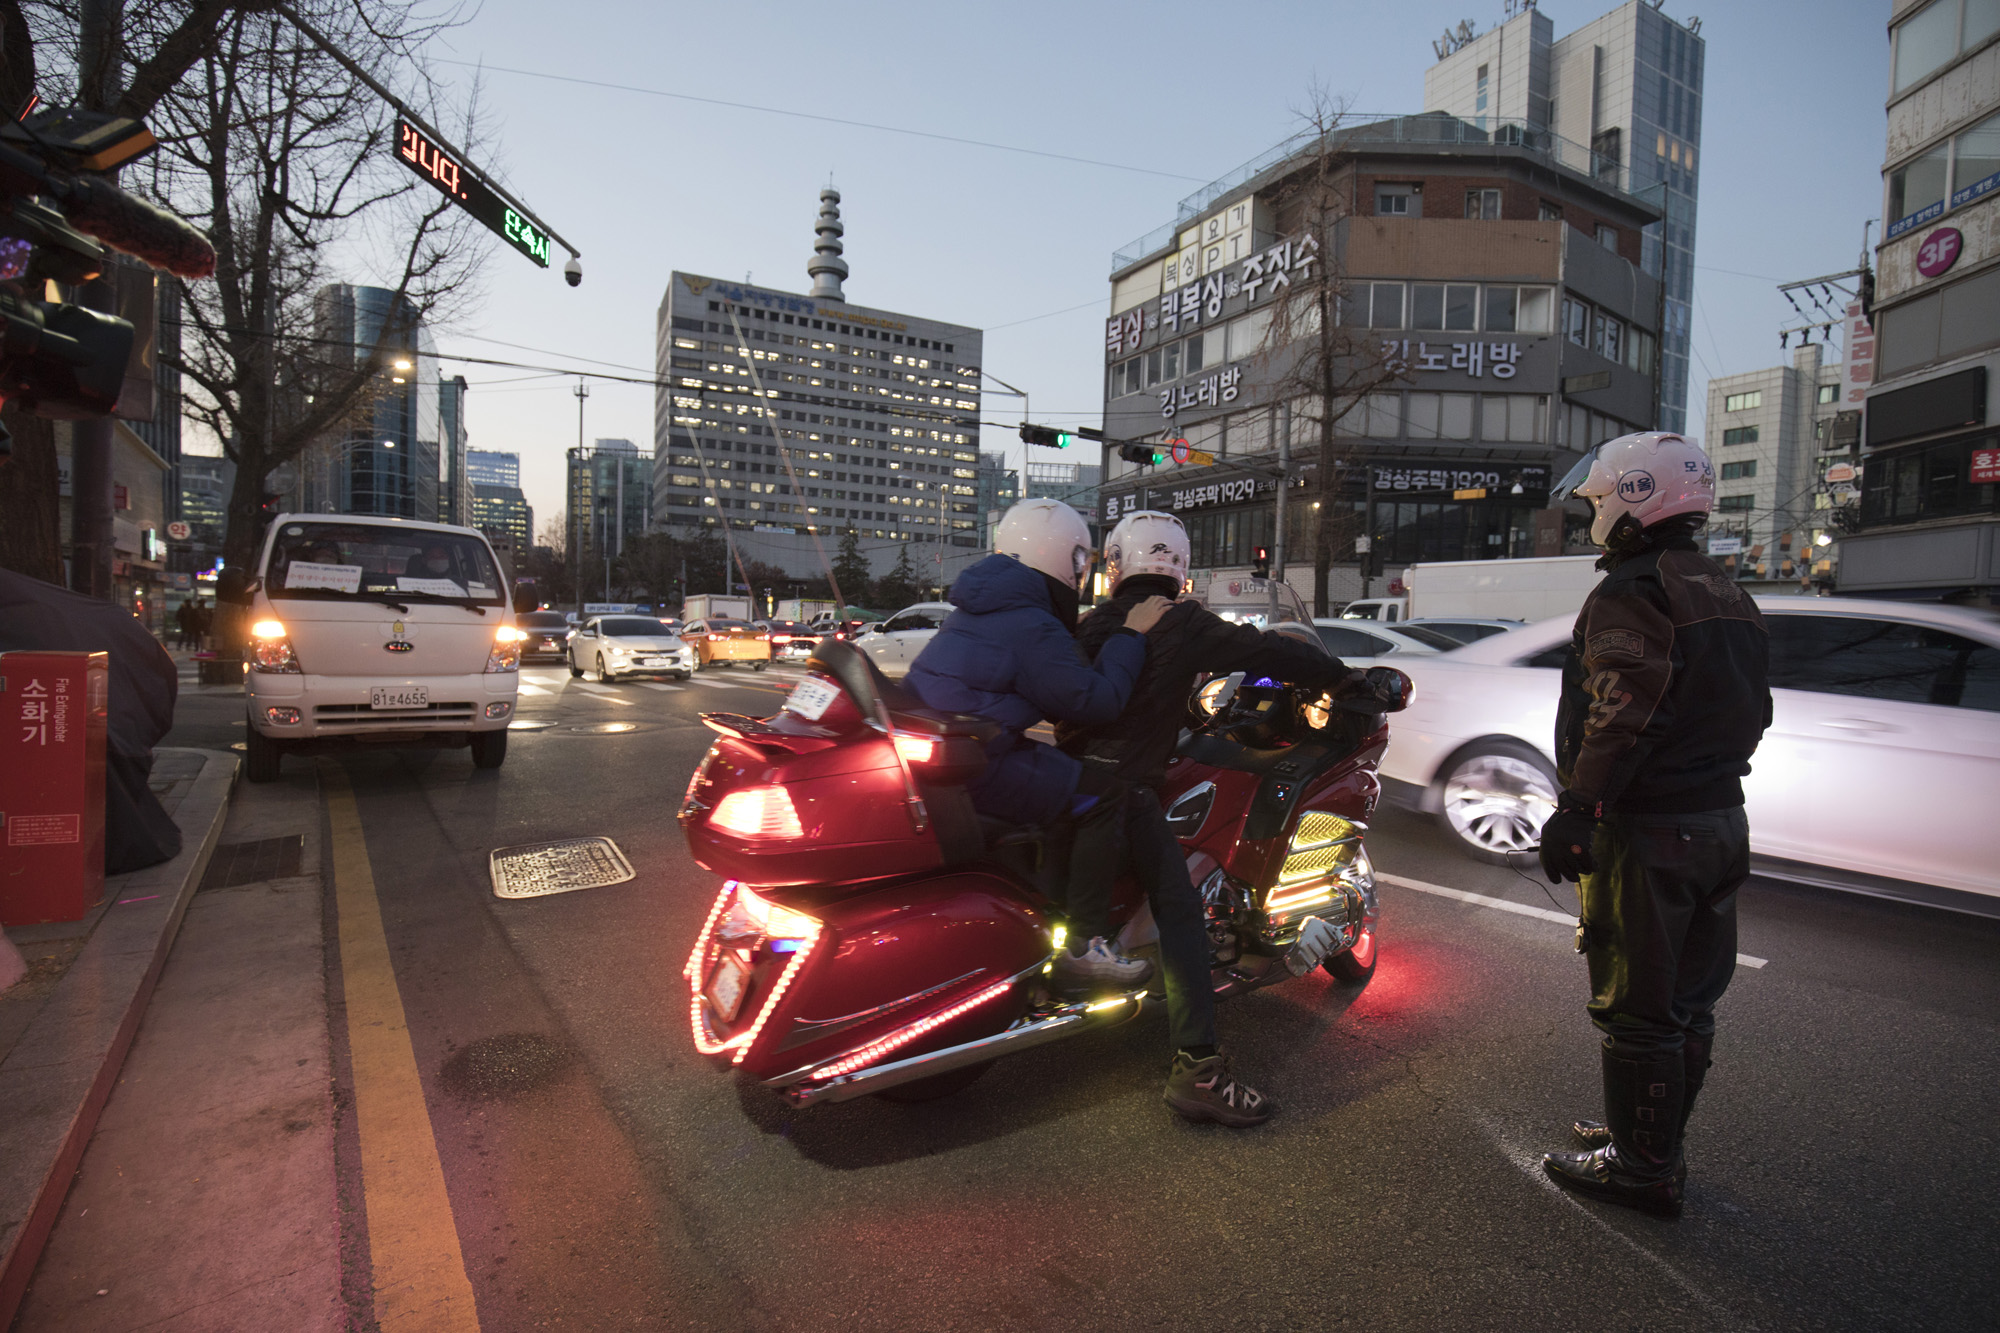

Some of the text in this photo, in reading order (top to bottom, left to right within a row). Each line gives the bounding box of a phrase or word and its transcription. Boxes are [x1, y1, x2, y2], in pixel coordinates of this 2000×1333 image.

[505, 208, 550, 266] 단속시
[1208, 204, 1246, 240] 요가
[1166, 234, 1243, 282] 복싱 PT
[1920, 233, 1956, 269] 3F
[1107, 308, 1143, 354] 복싱
[1161, 272, 1225, 332] 킥복싱
[1242, 233, 1319, 302] 주짓수
[1381, 339, 1522, 379] 킹노래방
[1160, 367, 1242, 418] 킹노래방
[1173, 479, 1255, 509] 경성주막1929
[1620, 477, 1652, 494] 서울
[171, 523, 188, 537] 약
[21, 679, 48, 745] 소화기
[53, 678, 69, 743] Fire Extinguisher
